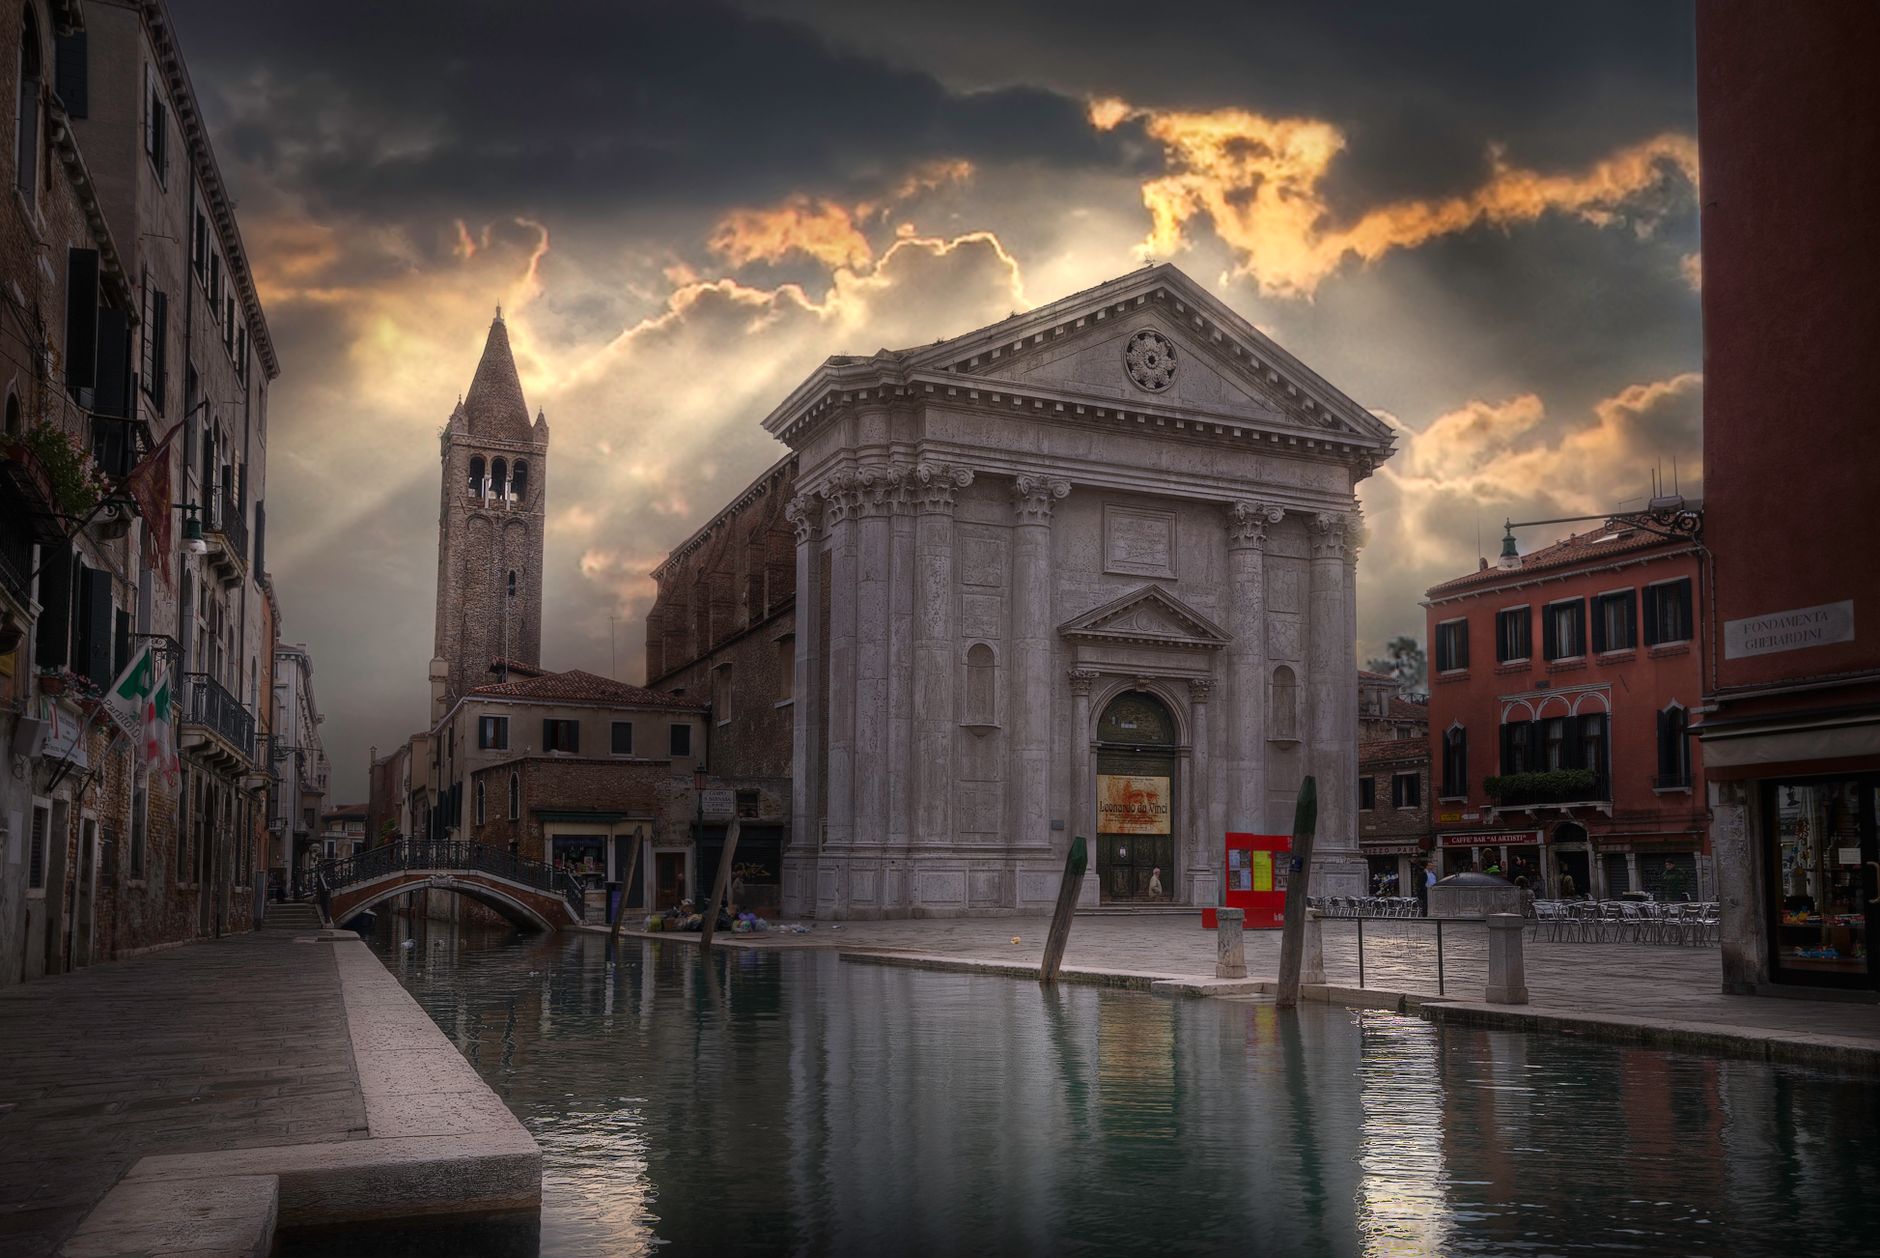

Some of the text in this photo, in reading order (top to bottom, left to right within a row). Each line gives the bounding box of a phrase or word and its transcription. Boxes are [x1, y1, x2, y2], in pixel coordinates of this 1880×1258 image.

[1744, 611, 1828, 634] FONDAMENTA
[1745, 628, 1824, 650] GHERARDINI
[1099, 800, 1168, 815] Leonardo da Vinci
